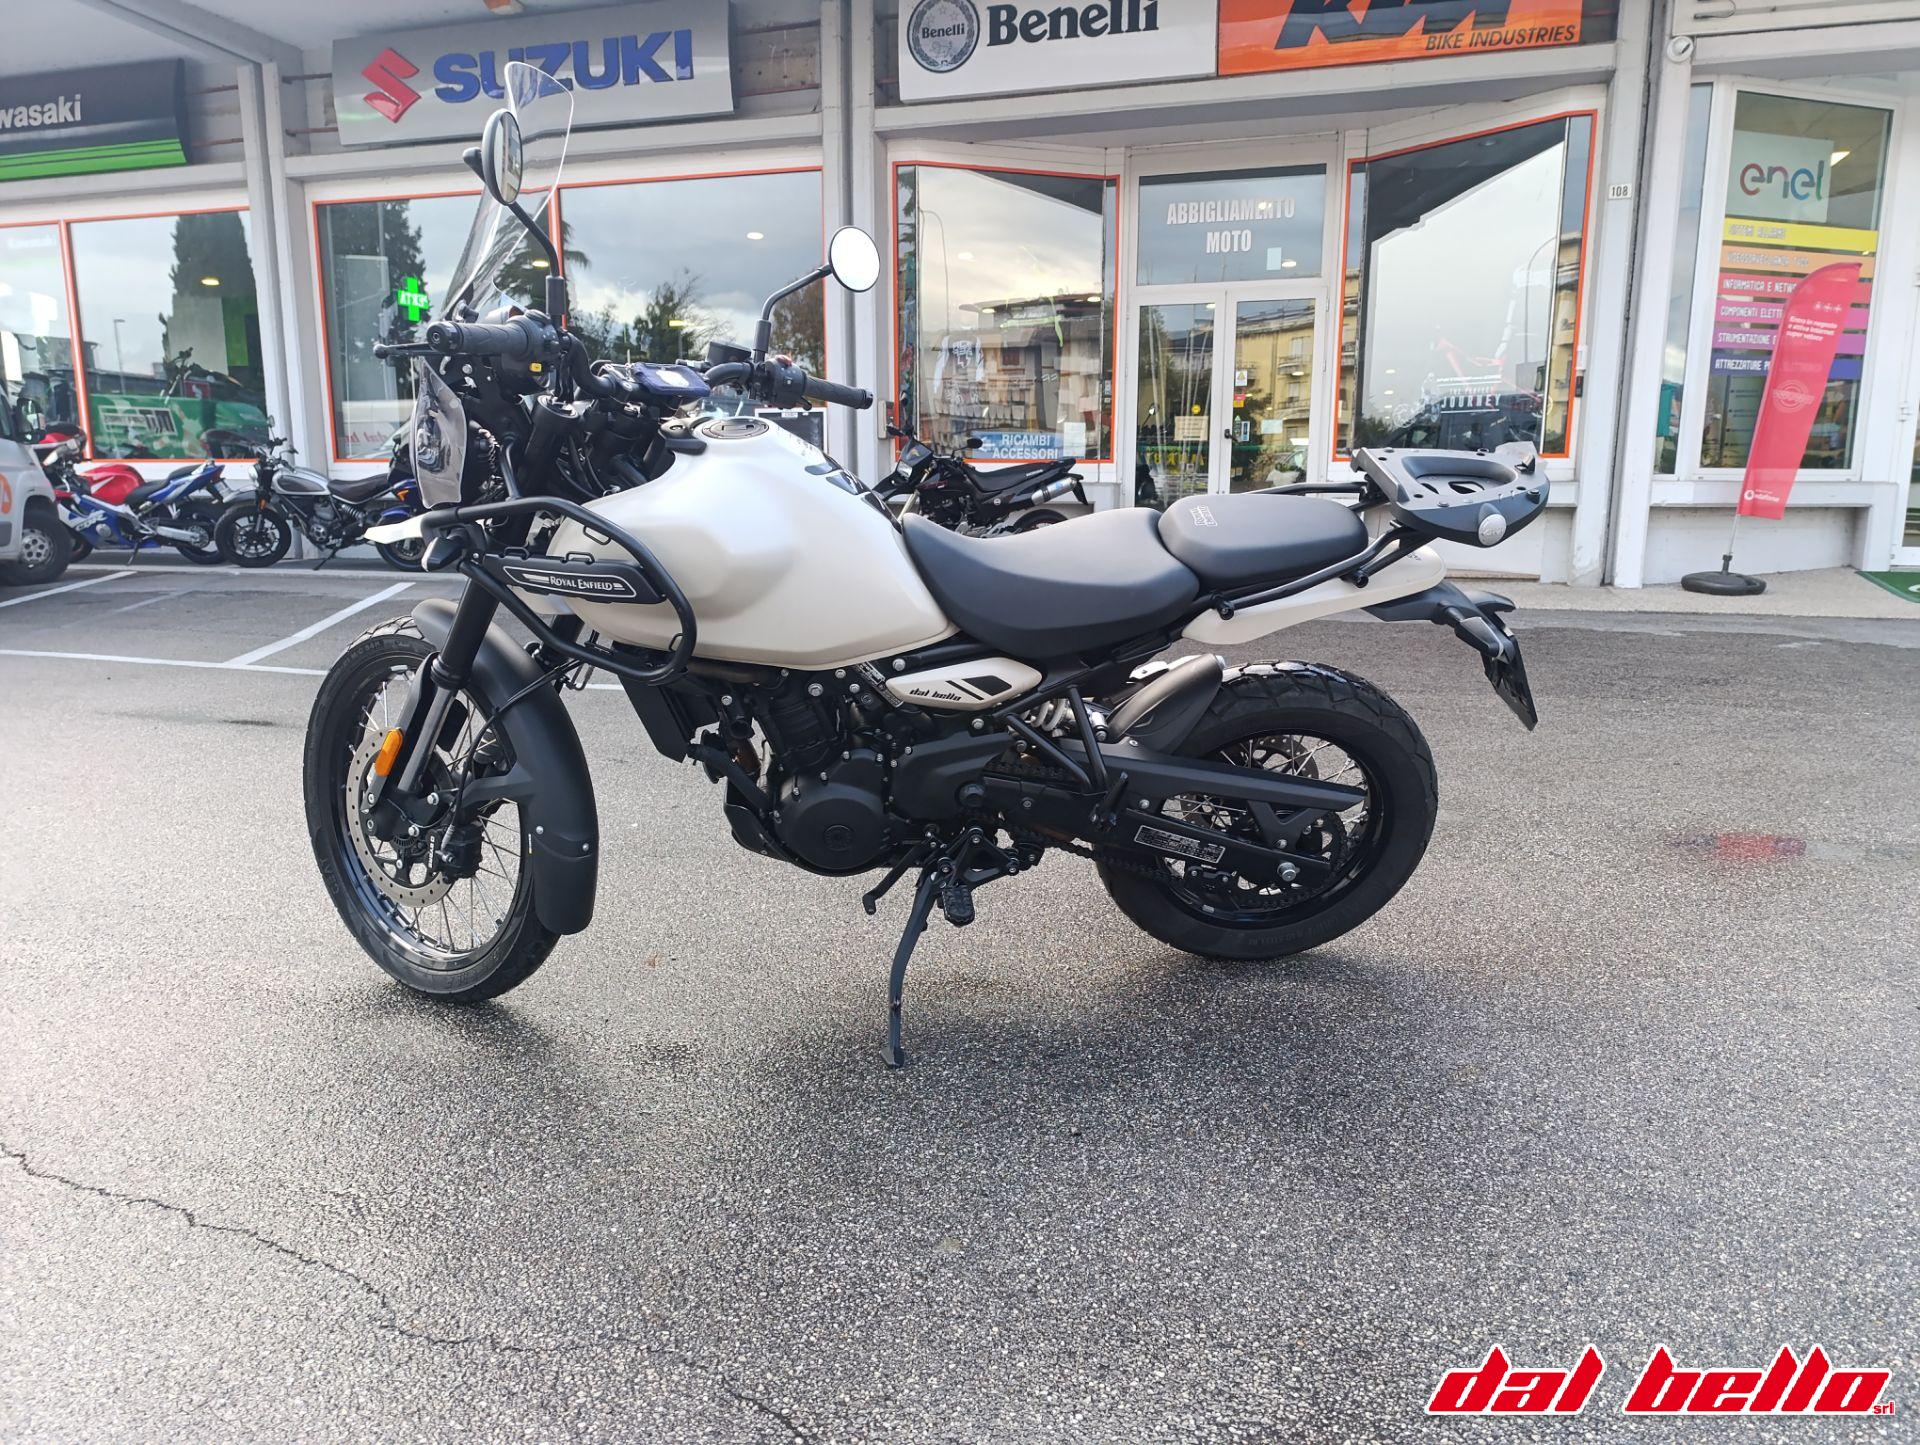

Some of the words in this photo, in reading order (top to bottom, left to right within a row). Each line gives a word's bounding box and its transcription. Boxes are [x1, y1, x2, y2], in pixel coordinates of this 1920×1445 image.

[921, 22, 965, 39] Benelli
[987, 0, 1160, 47] Benelli
[1425, 31, 1463, 51] BIKE
[1468, 25, 1577, 47] INDUSTRIES
[433, 29, 695, 103] SUZUKI
[1740, 160, 1824, 201] enel
[1612, 185, 1628, 197] 108
[1167, 197, 1296, 225] ABBIGLIAMENTO
[1206, 229, 1252, 254] MOTO
[1723, 278, 1765, 293] INFORMATICA
[1767, 281, 1772, 292] E
[1720, 305, 1758, 318] COMPONENTI
[1718, 332, 1771, 345] STRUMENTAZIONE
[1715, 358, 1762, 371] ATTREZZATURE
[1441, 393, 1501, 409] JOURNEY
[1001, 433, 1051, 447] RICAMBI
[992, 447, 1058, 460] ACCESSORI
[550, 575, 577, 588] ROYAL
[577, 578, 613, 591] ENFIELD
[909, 687, 930, 697] dal
[931, 691, 962, 702] bello
